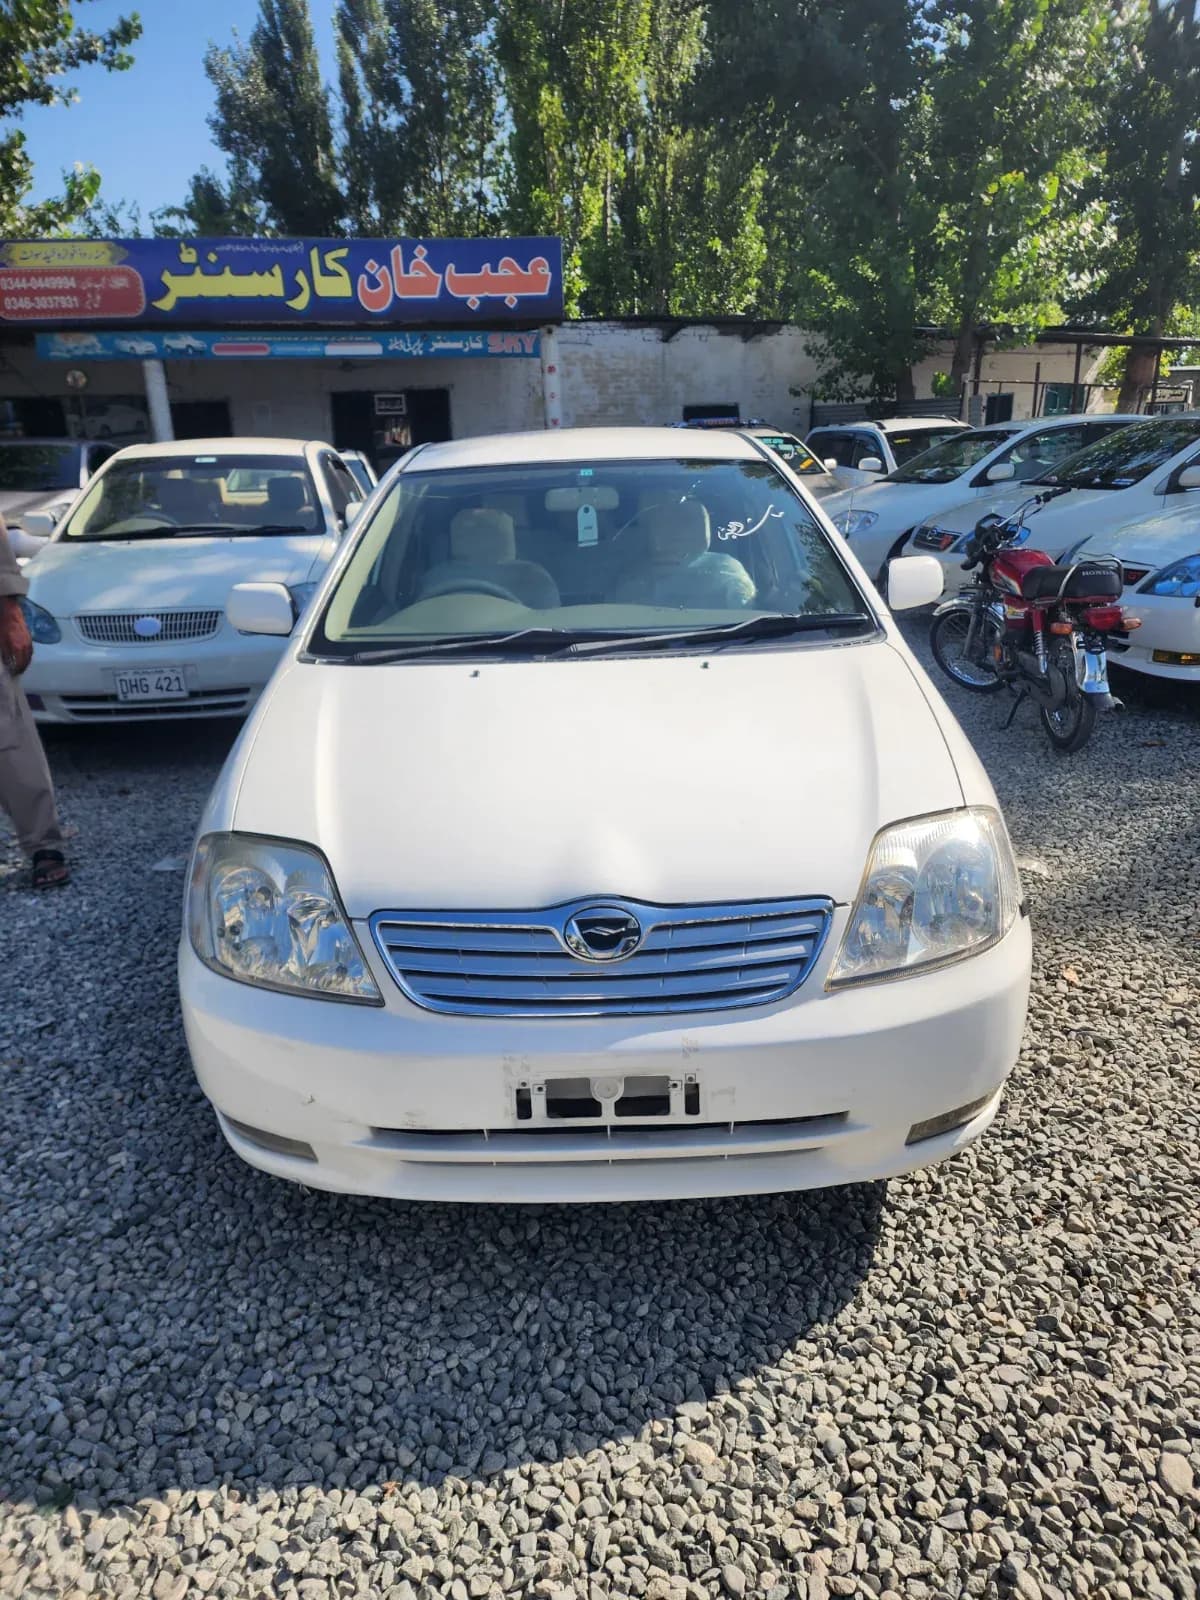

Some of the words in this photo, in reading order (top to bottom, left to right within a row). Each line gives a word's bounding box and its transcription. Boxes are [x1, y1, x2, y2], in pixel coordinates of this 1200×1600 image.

[152, 241, 284, 312] سنٹر
[285, 247, 353, 311] کار
[358, 244, 443, 313] خان
[445, 257, 552, 311] عجب
[487, 333, 537, 354] SKY
[154, 676, 185, 693] 421
